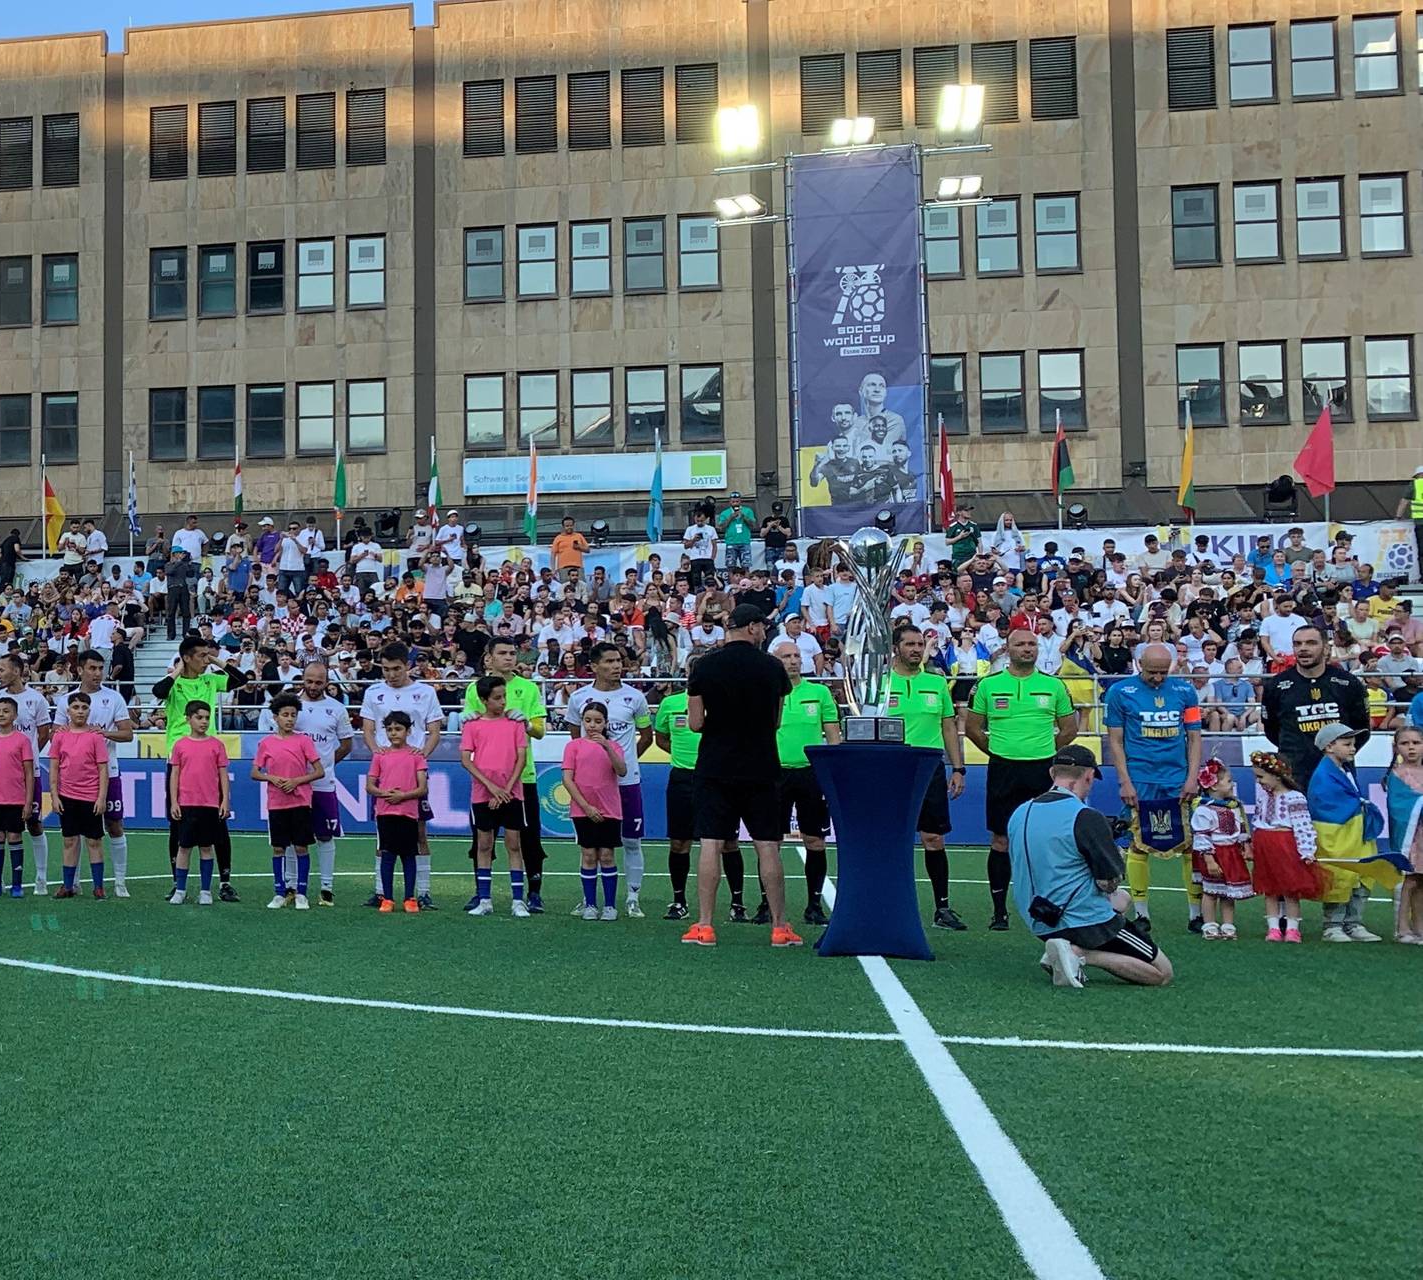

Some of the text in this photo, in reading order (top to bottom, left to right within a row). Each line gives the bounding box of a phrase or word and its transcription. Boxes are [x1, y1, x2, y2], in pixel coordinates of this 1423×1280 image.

[838, 325, 881, 334] socca
[823, 334, 895, 346] world cup
[473, 474, 509, 484] Software
[551, 473, 583, 481] Wissen
[690, 476, 722, 486] DATEV
[633, 818, 643, 832] 7
